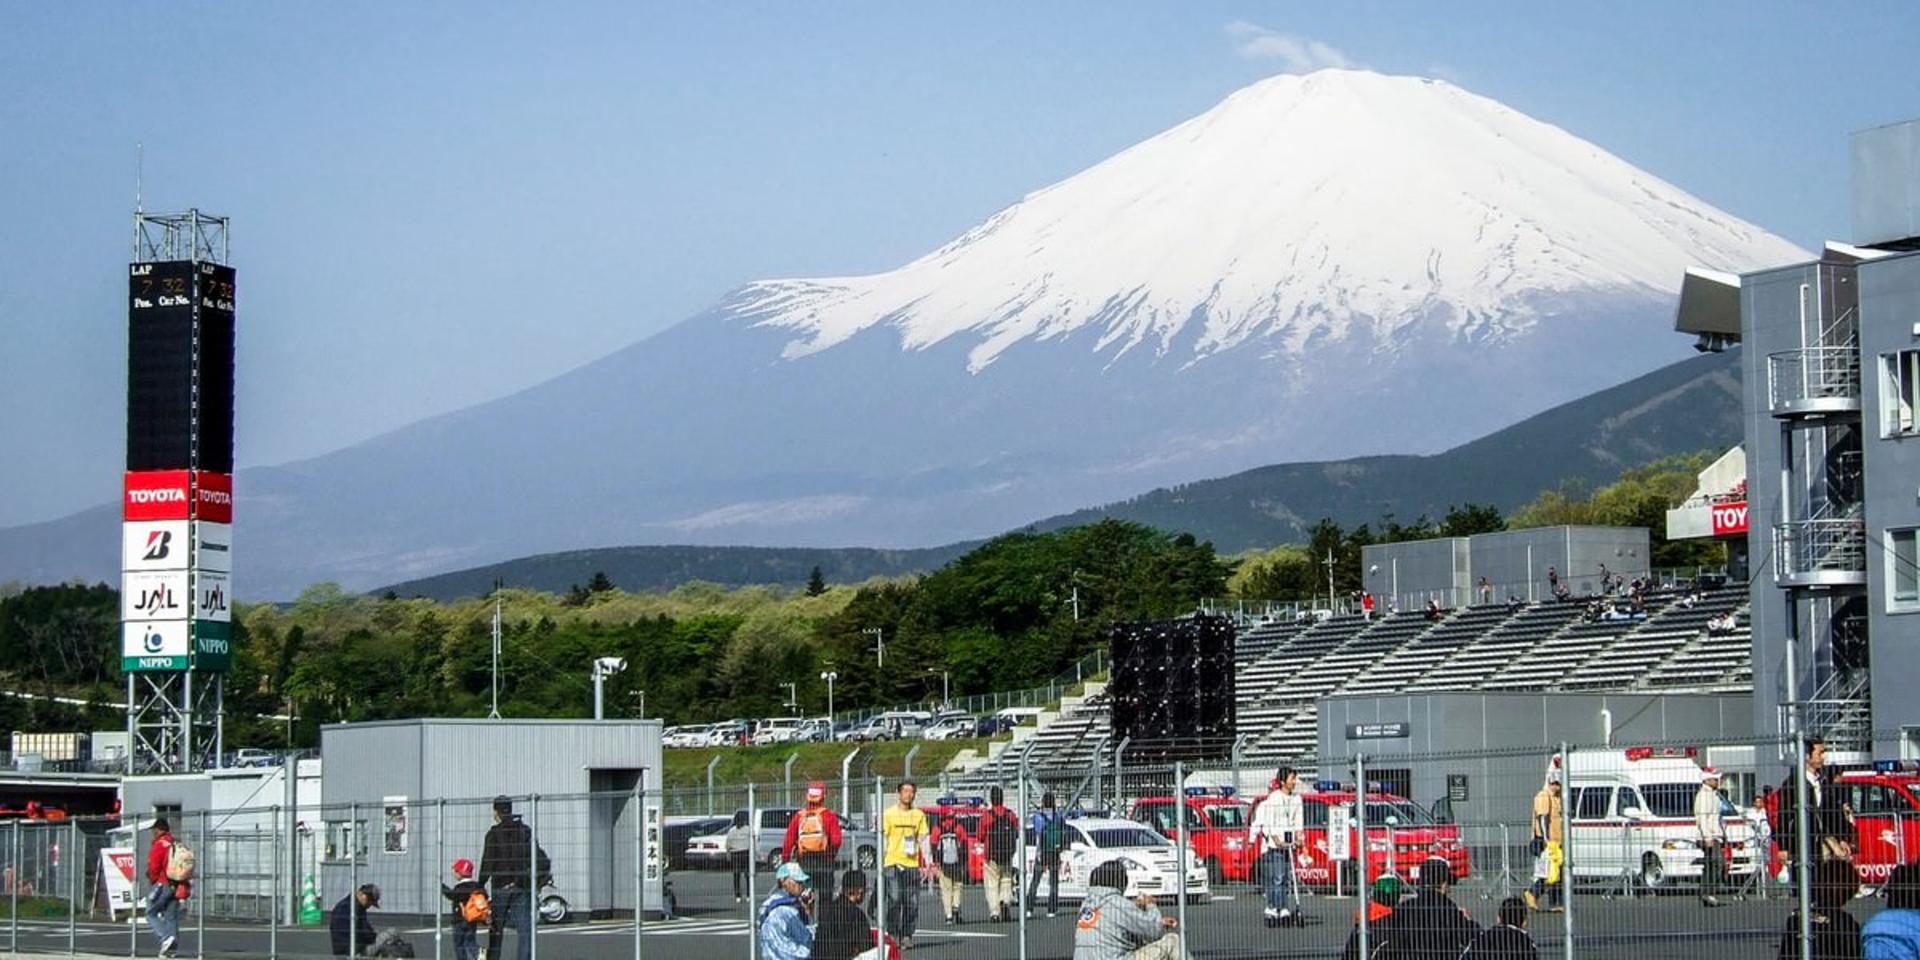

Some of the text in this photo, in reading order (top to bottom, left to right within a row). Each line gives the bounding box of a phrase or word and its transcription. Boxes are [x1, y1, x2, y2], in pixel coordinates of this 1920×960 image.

[131, 265, 153, 275] LAP
[128, 489, 186, 503] TOYOTA
[199, 489, 231, 504] TOYOTA
[1713, 507, 1748, 529] TOY
[134, 583, 179, 616] JAL
[201, 584, 226, 617] JAL
[198, 638, 228, 654] NIPPO
[139, 657, 173, 668] NIPPO
[116, 857, 134, 868] STO
[1854, 864, 1897, 877] TOYOT
